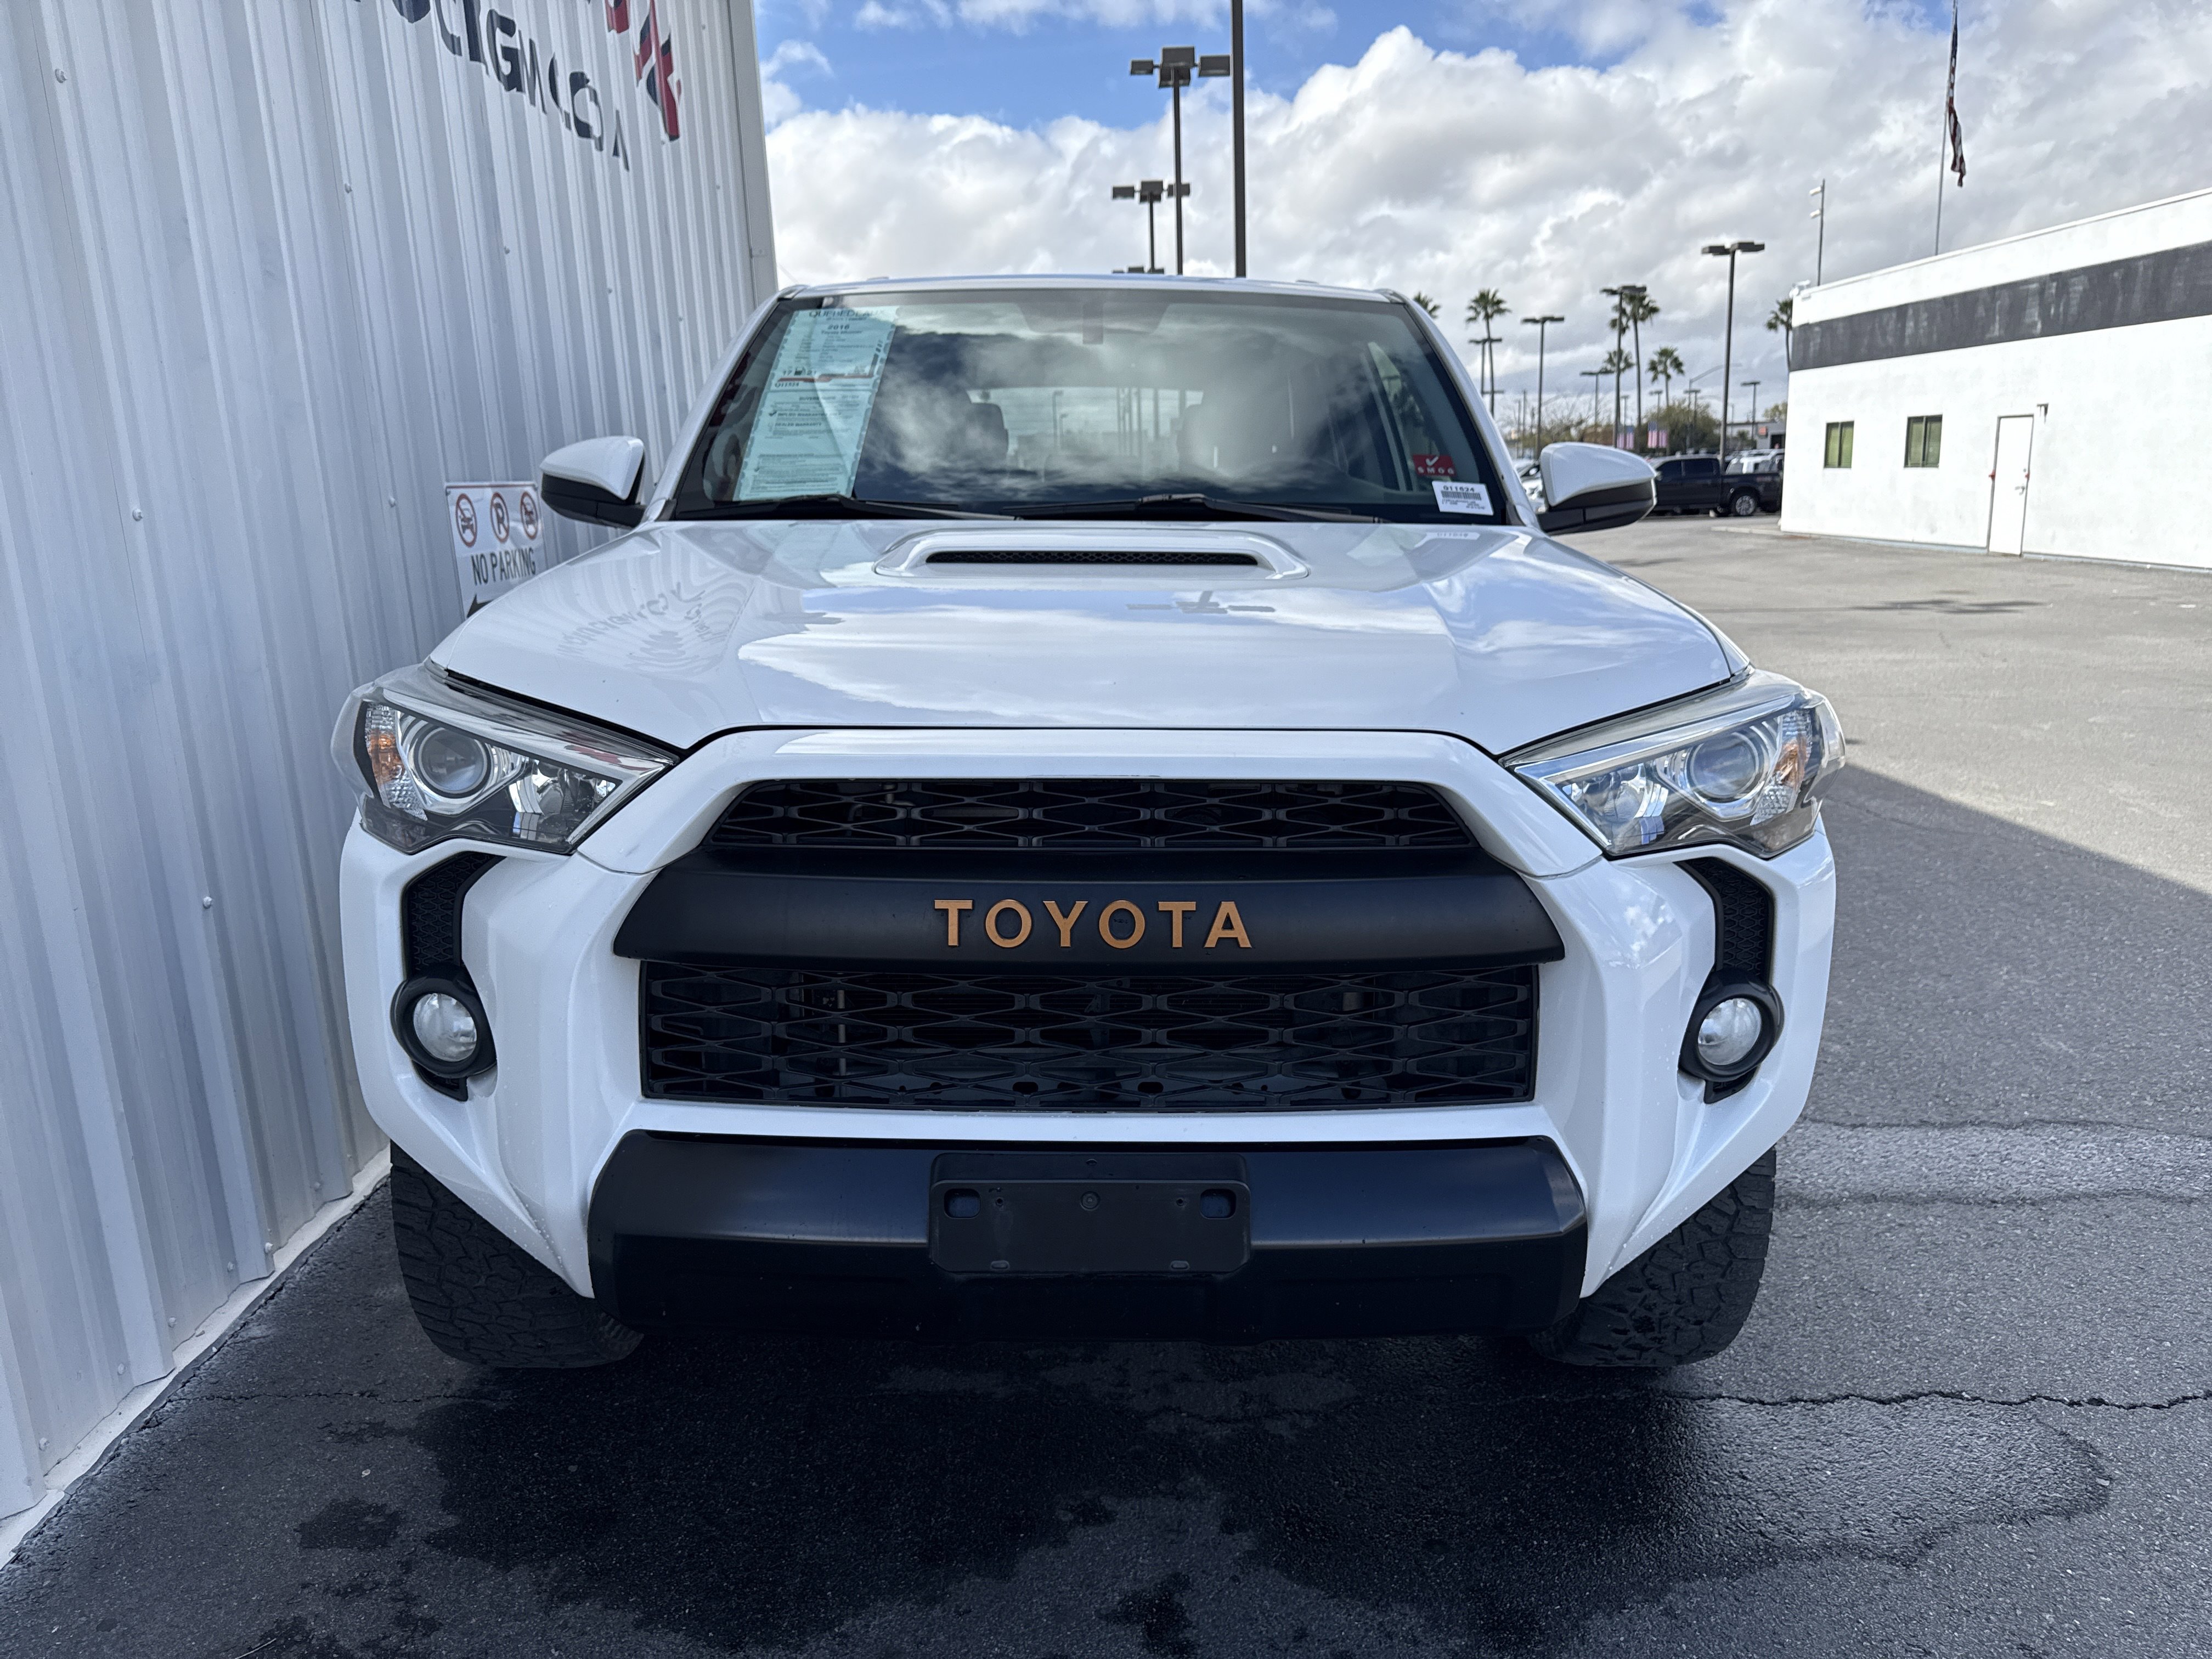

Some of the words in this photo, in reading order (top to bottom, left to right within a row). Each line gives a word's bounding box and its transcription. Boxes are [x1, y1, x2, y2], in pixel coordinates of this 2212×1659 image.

[1417, 466, 1454, 475] SMOG
[471, 553, 489, 586] NO
[489, 547, 536, 582] PARKING
[934, 899, 1252, 949] TOYOTA
